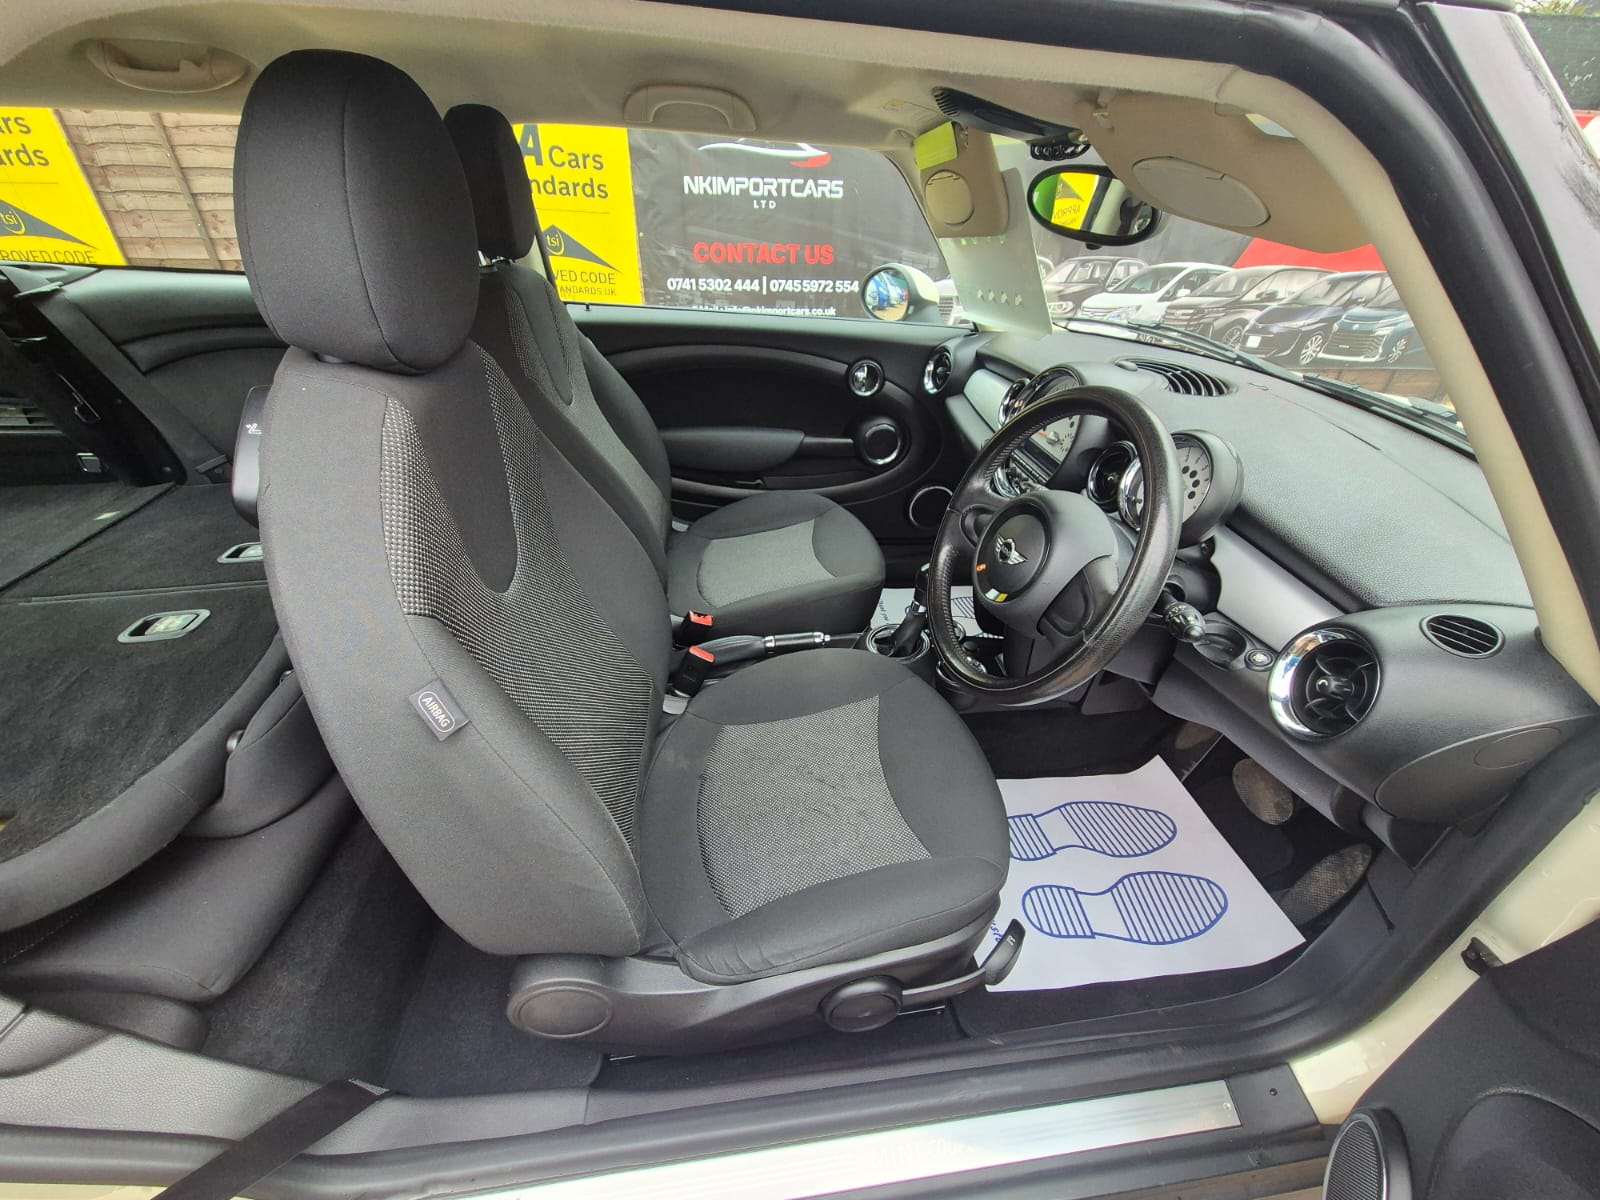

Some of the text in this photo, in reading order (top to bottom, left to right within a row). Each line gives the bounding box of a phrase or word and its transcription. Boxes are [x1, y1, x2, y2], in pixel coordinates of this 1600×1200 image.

[548, 145, 605, 171] Cars
[683, 175, 844, 199] NKIMPORTCARS
[753, 200, 777, 209] LTD
[53, 250, 98, 264] CODE
[693, 241, 835, 265] CONTACT US
[580, 271, 617, 285] CODE
[734, 279, 761, 293] 444
[835, 281, 860, 294] 554
[422, 696, 451, 728] AIRBAG
